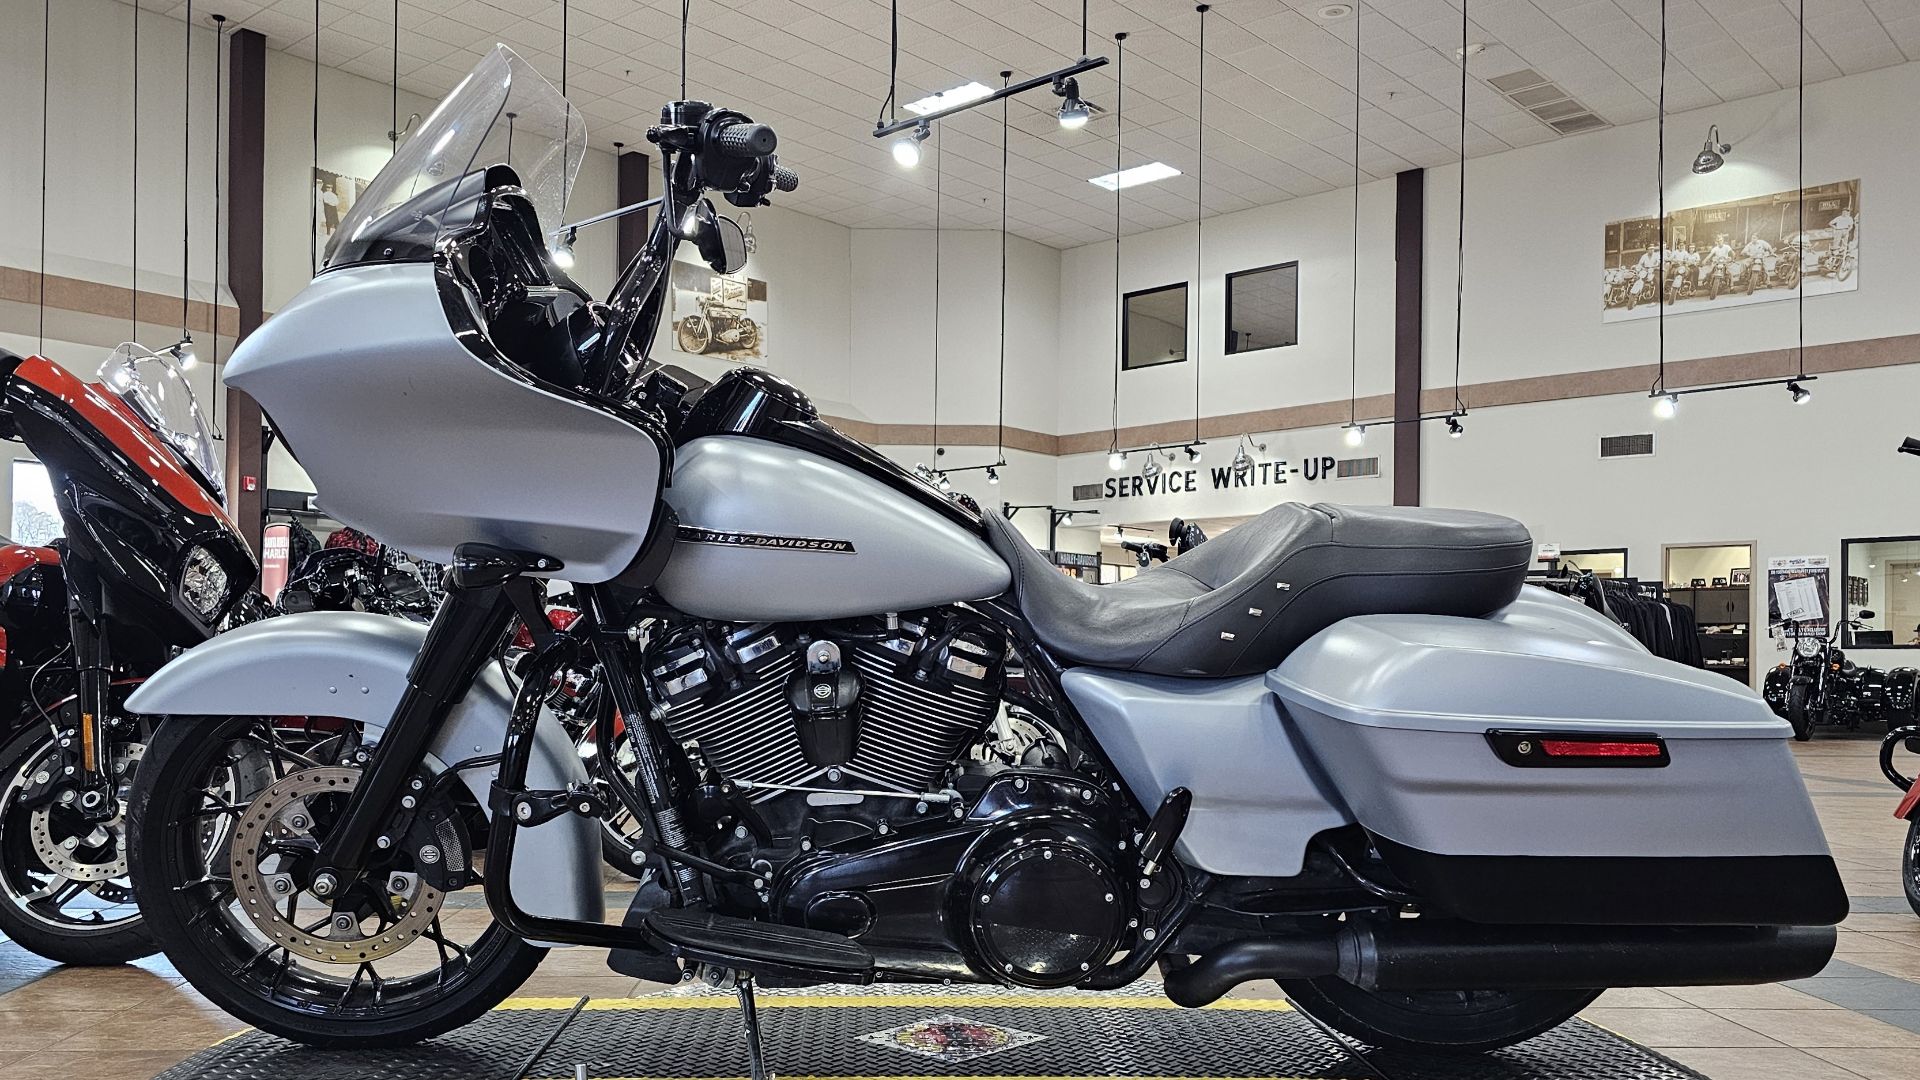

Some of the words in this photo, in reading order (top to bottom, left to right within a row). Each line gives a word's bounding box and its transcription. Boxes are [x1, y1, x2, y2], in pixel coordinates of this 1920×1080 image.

[1104, 470, 1197, 498] SERVICE
[1211, 456, 1336, 489] WRITE-UP
[678, 529, 847, 551] ARLEY-DAVIDSON
